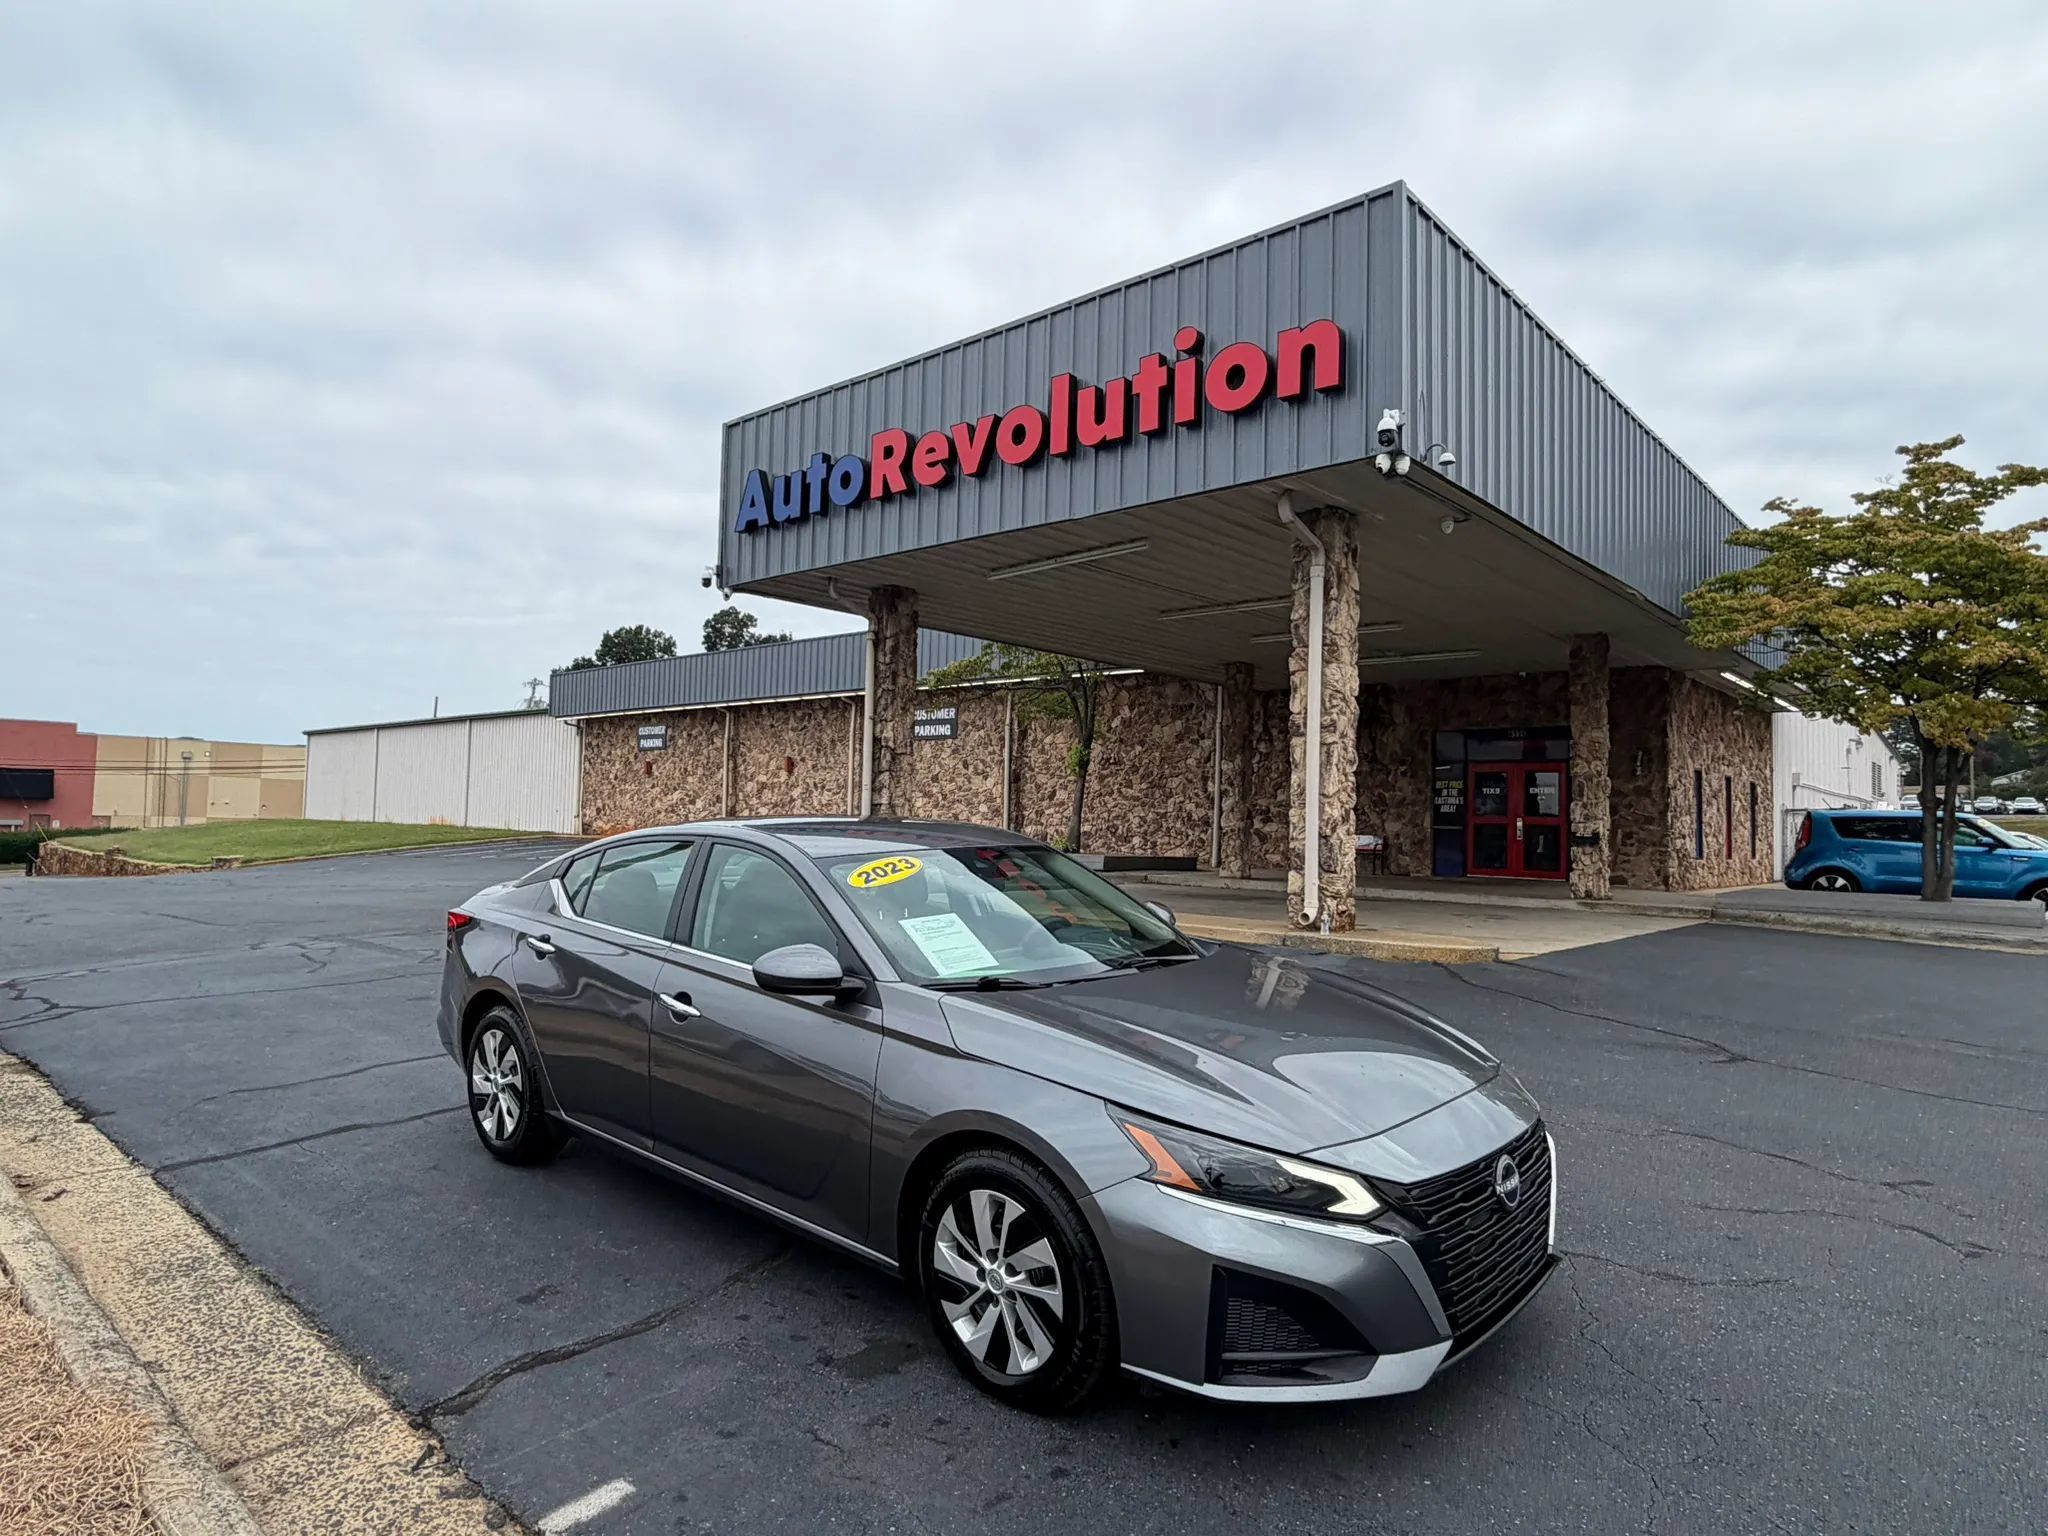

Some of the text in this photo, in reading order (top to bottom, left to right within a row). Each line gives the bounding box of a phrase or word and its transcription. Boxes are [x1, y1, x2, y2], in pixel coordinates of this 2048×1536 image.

[638, 725, 666, 736] CUSTOMER
[914, 724, 951, 736] PARKING
[640, 738, 662, 748] PARKING
[857, 858, 915, 884] 2023
